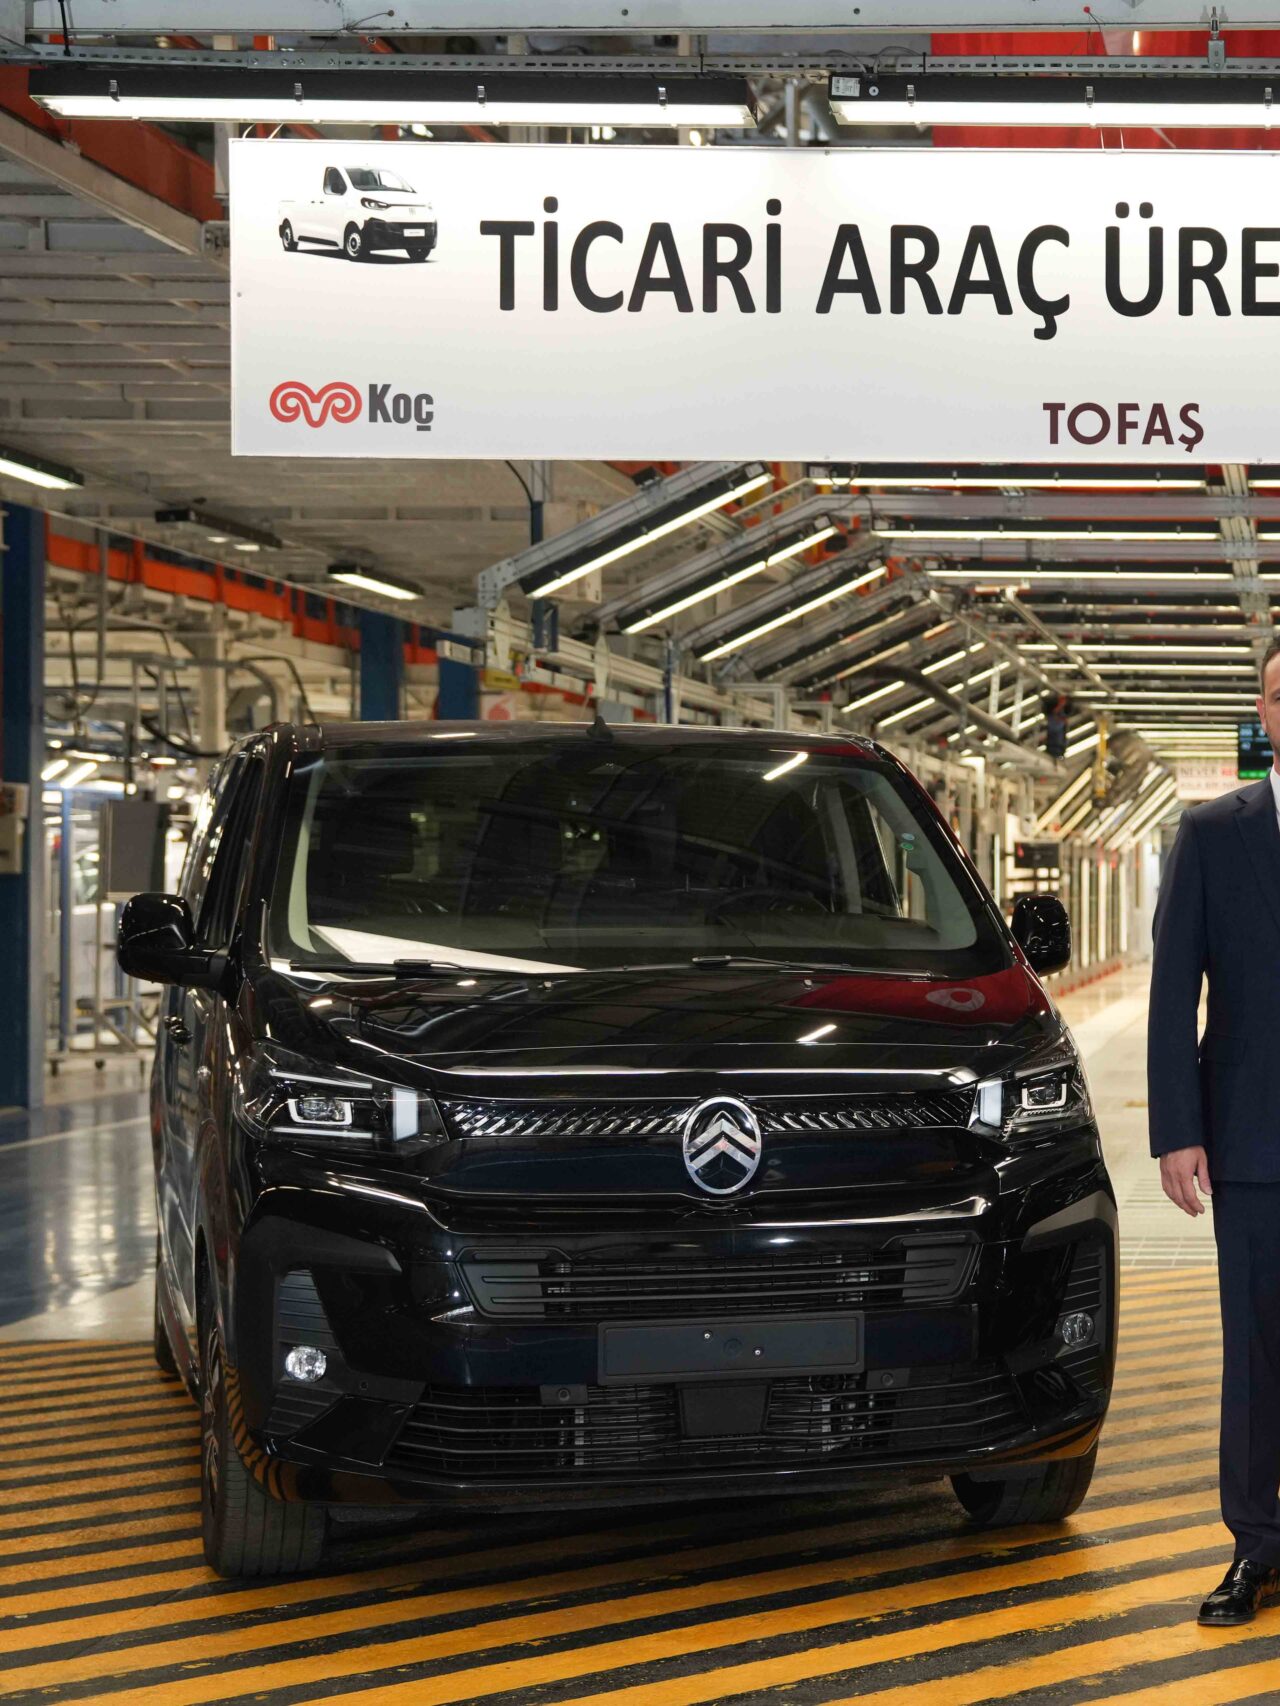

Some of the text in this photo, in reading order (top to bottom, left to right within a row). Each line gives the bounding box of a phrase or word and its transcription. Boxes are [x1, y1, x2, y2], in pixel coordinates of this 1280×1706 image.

[480, 196, 782, 314] TİCARİ
[816, 223, 1071, 341] ARAÇ
[368, 383, 434, 432] Koç
[1043, 402, 1205, 453] TOFAŞ
